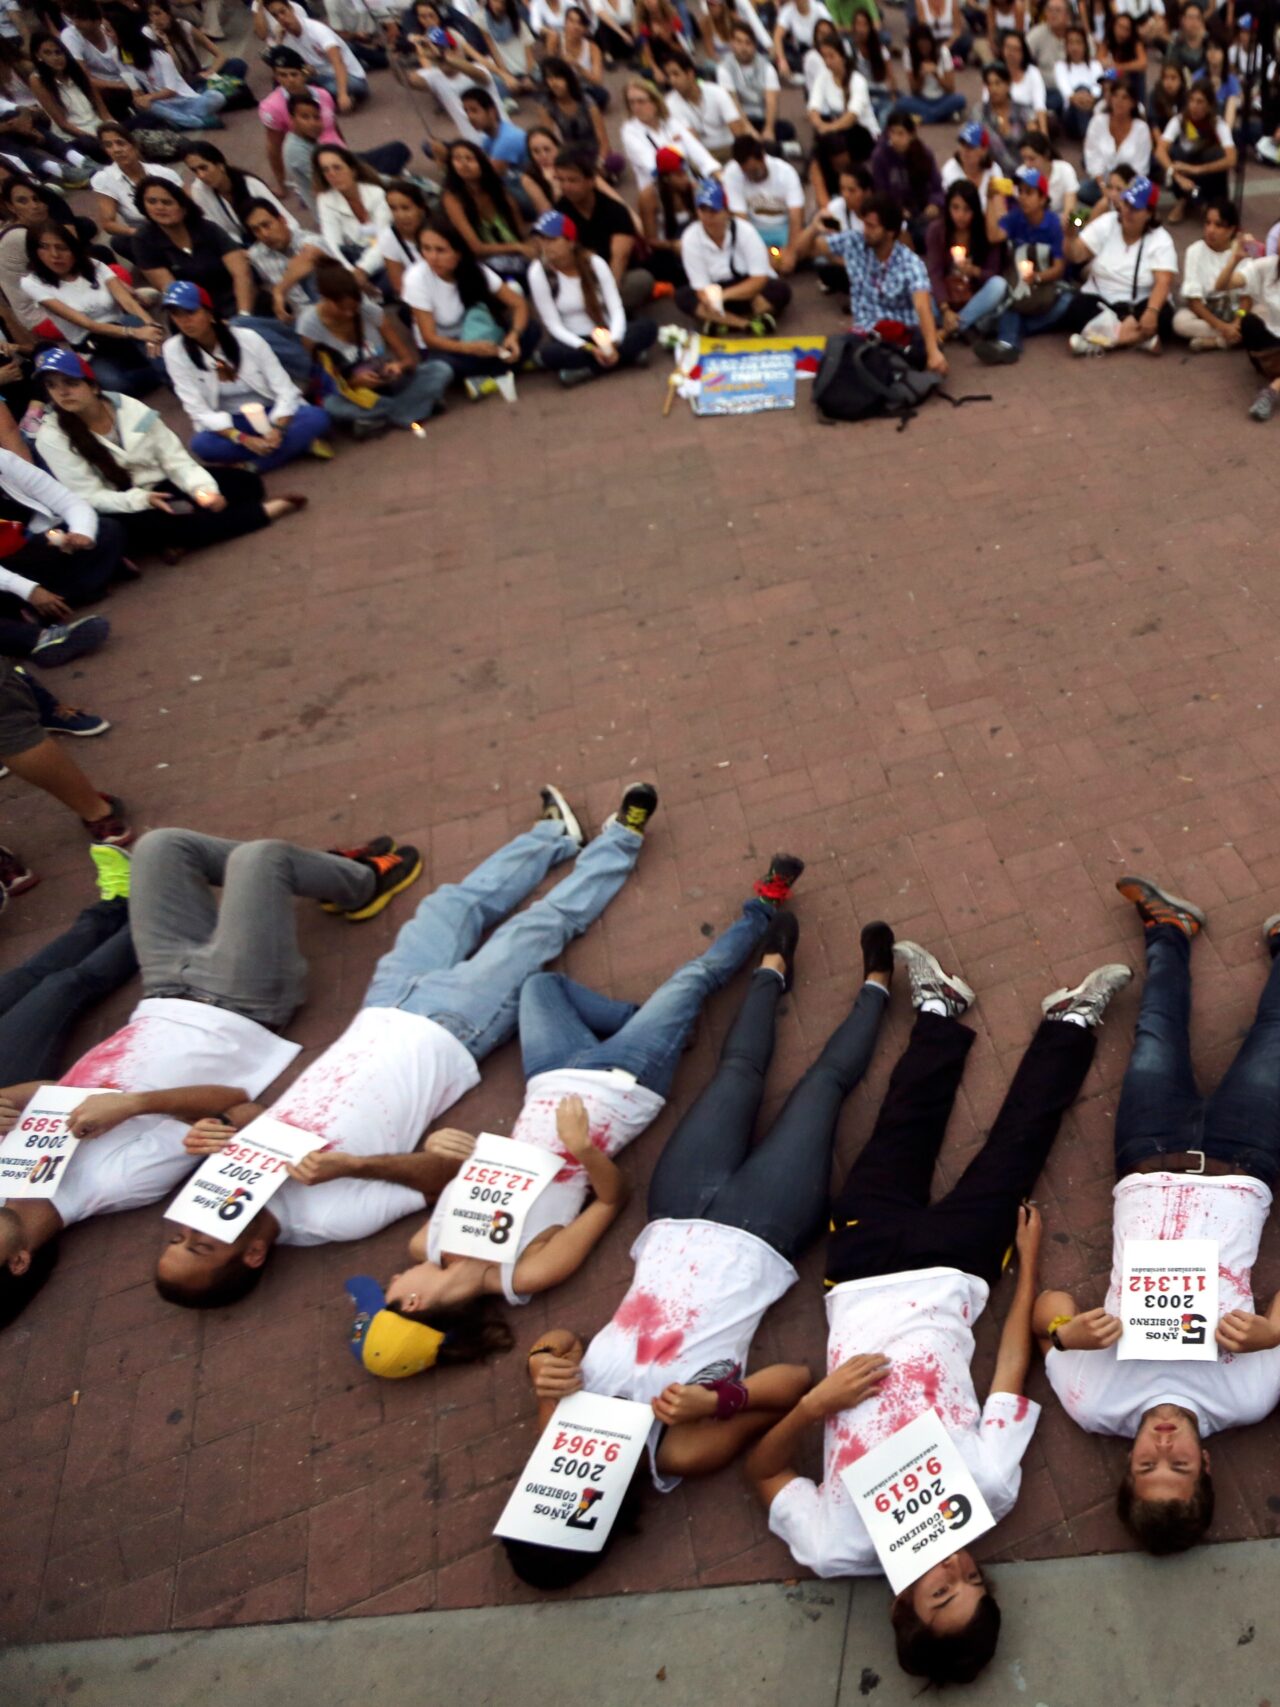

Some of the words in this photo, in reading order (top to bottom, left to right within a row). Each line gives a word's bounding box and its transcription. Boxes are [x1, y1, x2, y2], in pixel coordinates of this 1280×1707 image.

[25, 1135, 68, 1148] 2008
[0, 1157, 38, 1166] GOBIERN
[29, 1155, 65, 1184] 10
[223, 1143, 287, 1173] 13.156
[218, 1163, 263, 1185] 2007
[463, 1166, 534, 1192] 12.257
[218, 1187, 253, 1221] 9
[469, 1186, 513, 1205] 2006
[489, 1210, 514, 1244] 8
[1129, 1276, 1206, 1292] 11.342
[1144, 1295, 1194, 1308] 2003
[1130, 1318, 1179, 1326] GOBIERNO
[1181, 1313, 1207, 1344] 5
[1146, 1332, 1179, 1341] AÑOS
[552, 1432, 621, 1462] 9.964
[550, 1456, 606, 1481] 2005
[525, 1482, 578, 1501] GOBIERNO
[874, 1457, 942, 1513] 9.619
[533, 1504, 570, 1520] AÑOS
[566, 1487, 605, 1531] 7
[892, 1478, 945, 1525] 2004
[938, 1494, 972, 1530] 6
[889, 1512, 940, 1552] GOBIERNO
[911, 1525, 945, 1553] AÑOS
